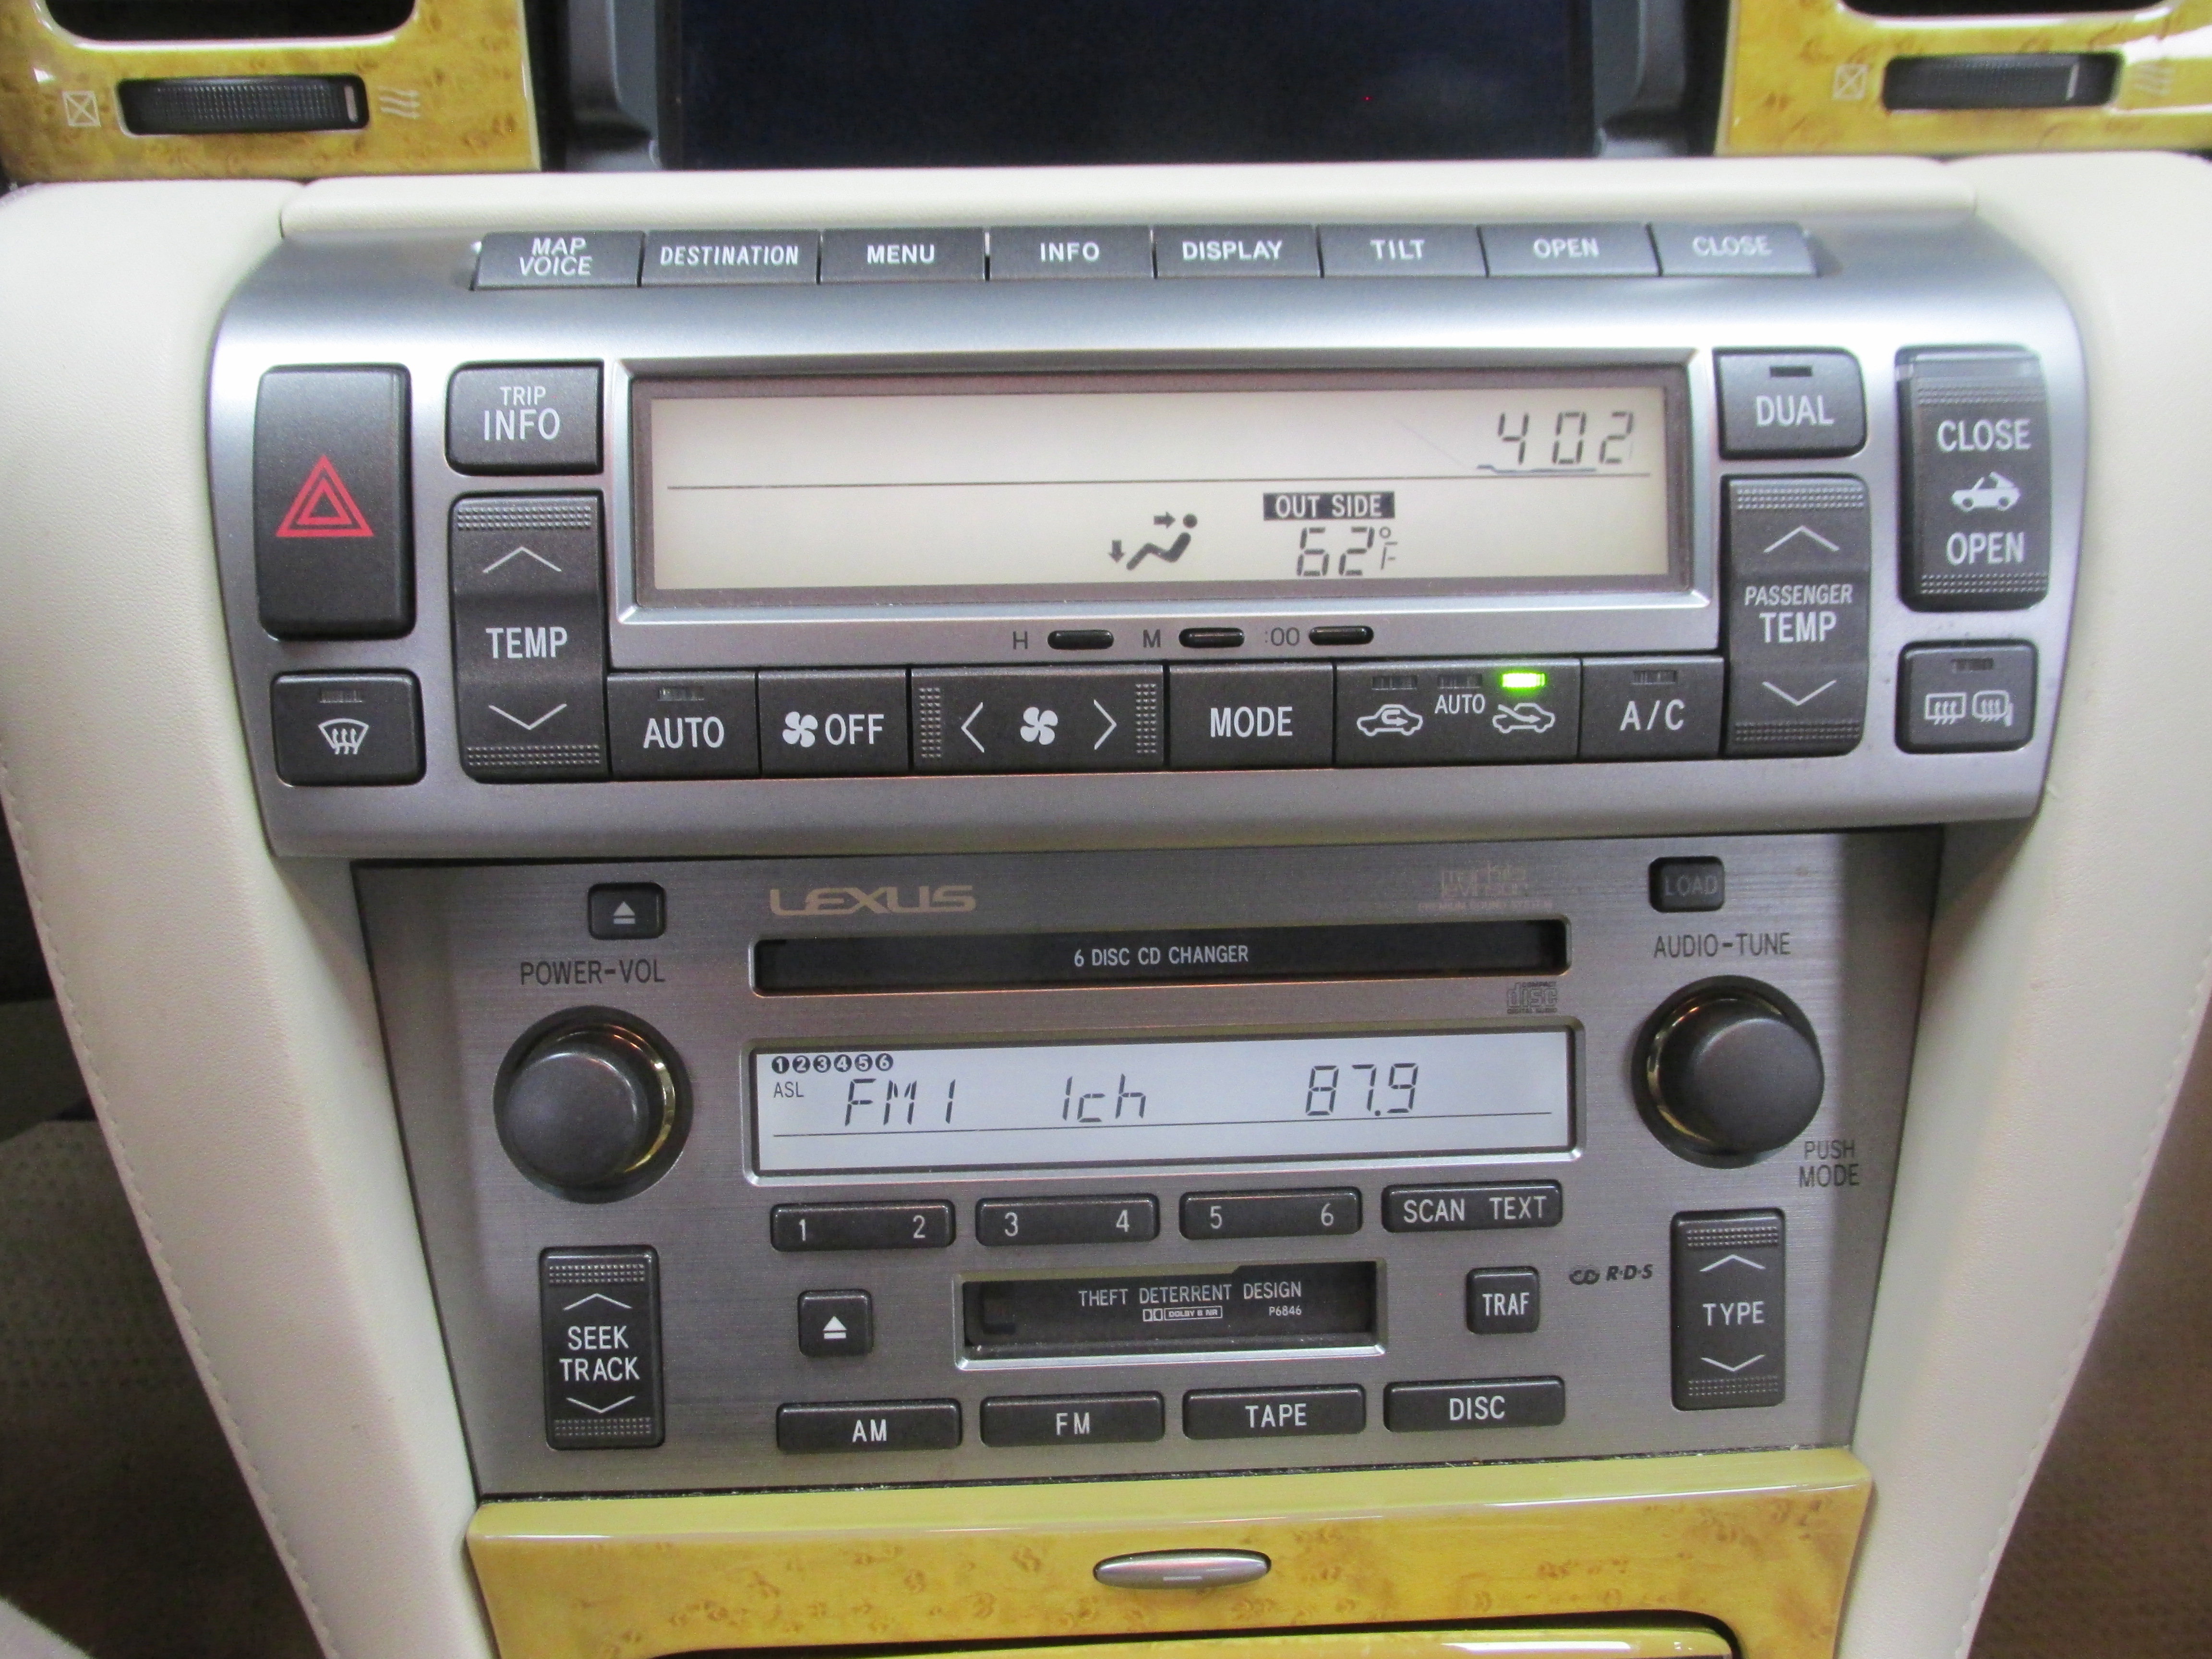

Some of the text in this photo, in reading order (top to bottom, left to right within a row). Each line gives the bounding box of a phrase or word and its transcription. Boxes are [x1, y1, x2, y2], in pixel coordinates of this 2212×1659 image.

[531, 237, 587, 256] MAP
[660, 246, 799, 266] DESTINATION
[866, 244, 936, 264] MENU
[1039, 241, 1101, 263] INFO
[1181, 240, 1283, 261] DISPLAY
[1370, 239, 1426, 260] TILT
[1532, 238, 1600, 259] OPEN
[1691, 235, 1773, 256] CLOSE
[518, 256, 593, 276] VOICE
[500, 386, 546, 406] TRIP
[1756, 395, 1835, 426] DUAL
[483, 407, 561, 441] INFO
[1936, 419, 2032, 452] CLOSE
[1496, 411, 1634, 466] 402
[1275, 493, 1382, 518] OUT SIDE
[1947, 532, 2025, 565] OPEN
[1744, 584, 1853, 606] PASSENGER
[1142, 628, 1162, 648] M
[1759, 611, 1838, 643] TEMP
[486, 626, 568, 659] TEMP
[1012, 631, 1028, 650] H
[1434, 694, 1486, 715] AUTO
[1620, 699, 1685, 731] A/C
[642, 717, 725, 749] AUTO
[824, 713, 884, 745] OFF
[1209, 707, 1293, 737] MODE
[1664, 875, 1719, 897] LOAD
[769, 885, 977, 916] LEXUS
[1073, 945, 1249, 967] 6 DISC CD CHANGER
[773, 1082, 805, 1098] ASL
[1305, 1063, 1419, 1117] 87.9
[1804, 1140, 1855, 1160] PUSH
[1799, 1165, 1860, 1188] MODE
[1210, 1206, 1223, 1229] 5
[1320, 1203, 1334, 1227] 6
[1403, 1199, 1465, 1223] SCAN
[1489, 1196, 1547, 1220] TEXT
[798, 1219, 806, 1241] 1
[912, 1215, 926, 1238] 2
[1004, 1213, 1019, 1237] 3
[1116, 1210, 1130, 1232] 4
[1078, 1281, 1302, 1306] THEFT DETERRENT DESIGN
[1482, 1292, 1530, 1317] TRAF
[1269, 1305, 1302, 1316] P6846
[1703, 1301, 1765, 1326] TYPE
[567, 1326, 629, 1350] SEEK
[559, 1357, 640, 1382] TRACK
[1245, 1403, 1307, 1428] TAPE
[1449, 1396, 1505, 1421] DISC
[853, 1419, 888, 1442] AM
[1056, 1412, 1091, 1435] FM
